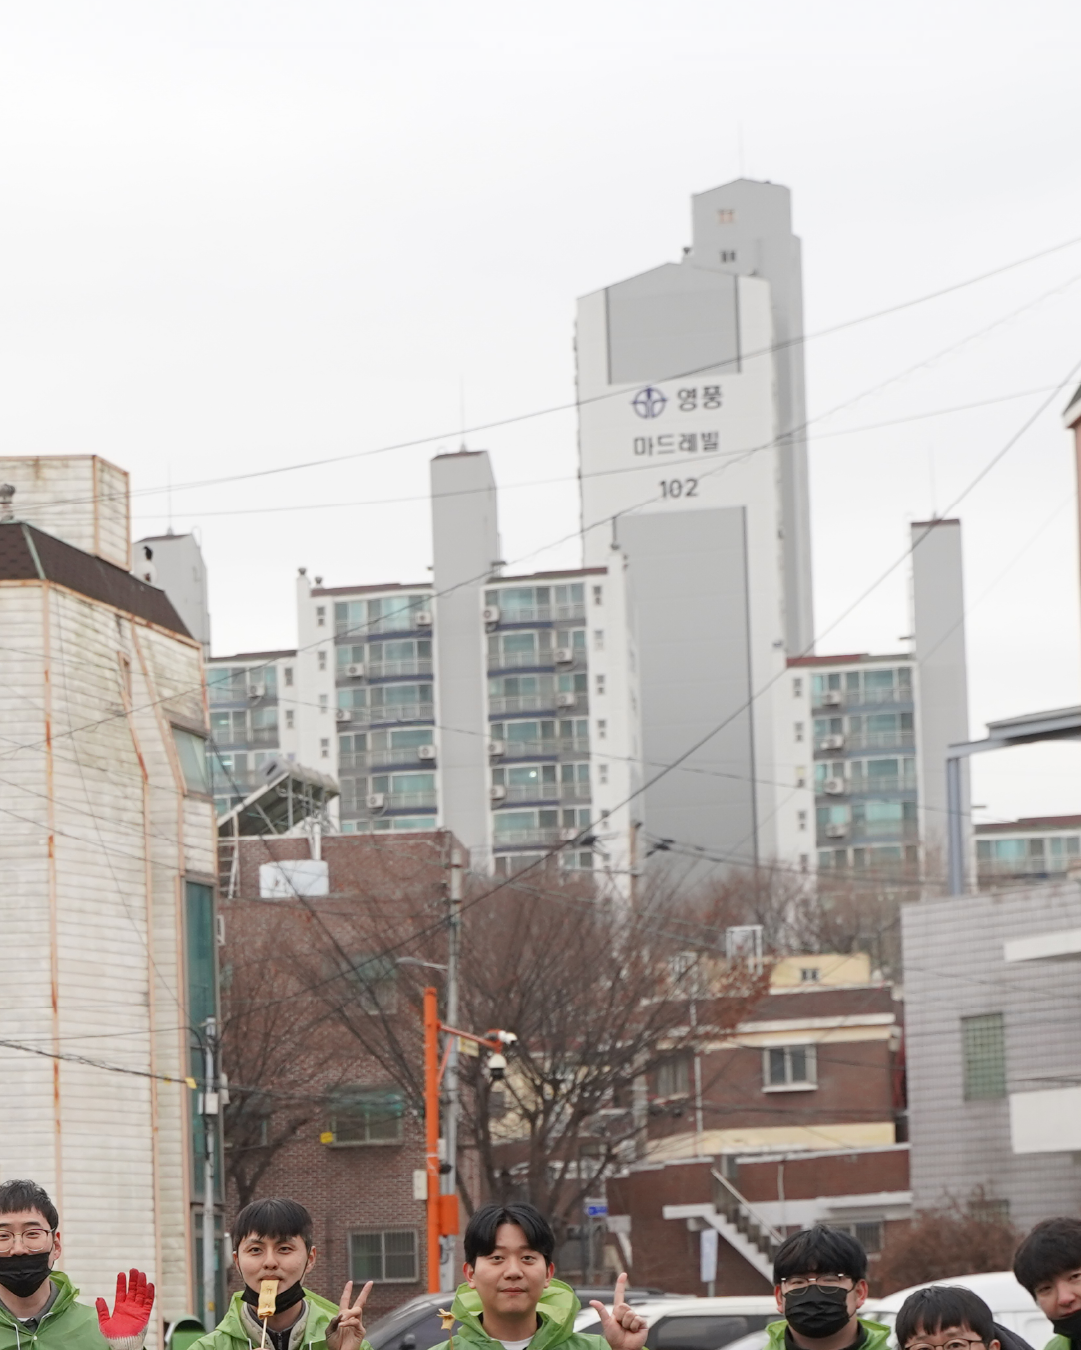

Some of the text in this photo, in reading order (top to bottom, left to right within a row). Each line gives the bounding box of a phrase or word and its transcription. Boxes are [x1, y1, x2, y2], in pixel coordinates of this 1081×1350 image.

[678, 385, 721, 412] 영풍
[633, 432, 719, 456] 마드레빌
[660, 478, 699, 499] 102
